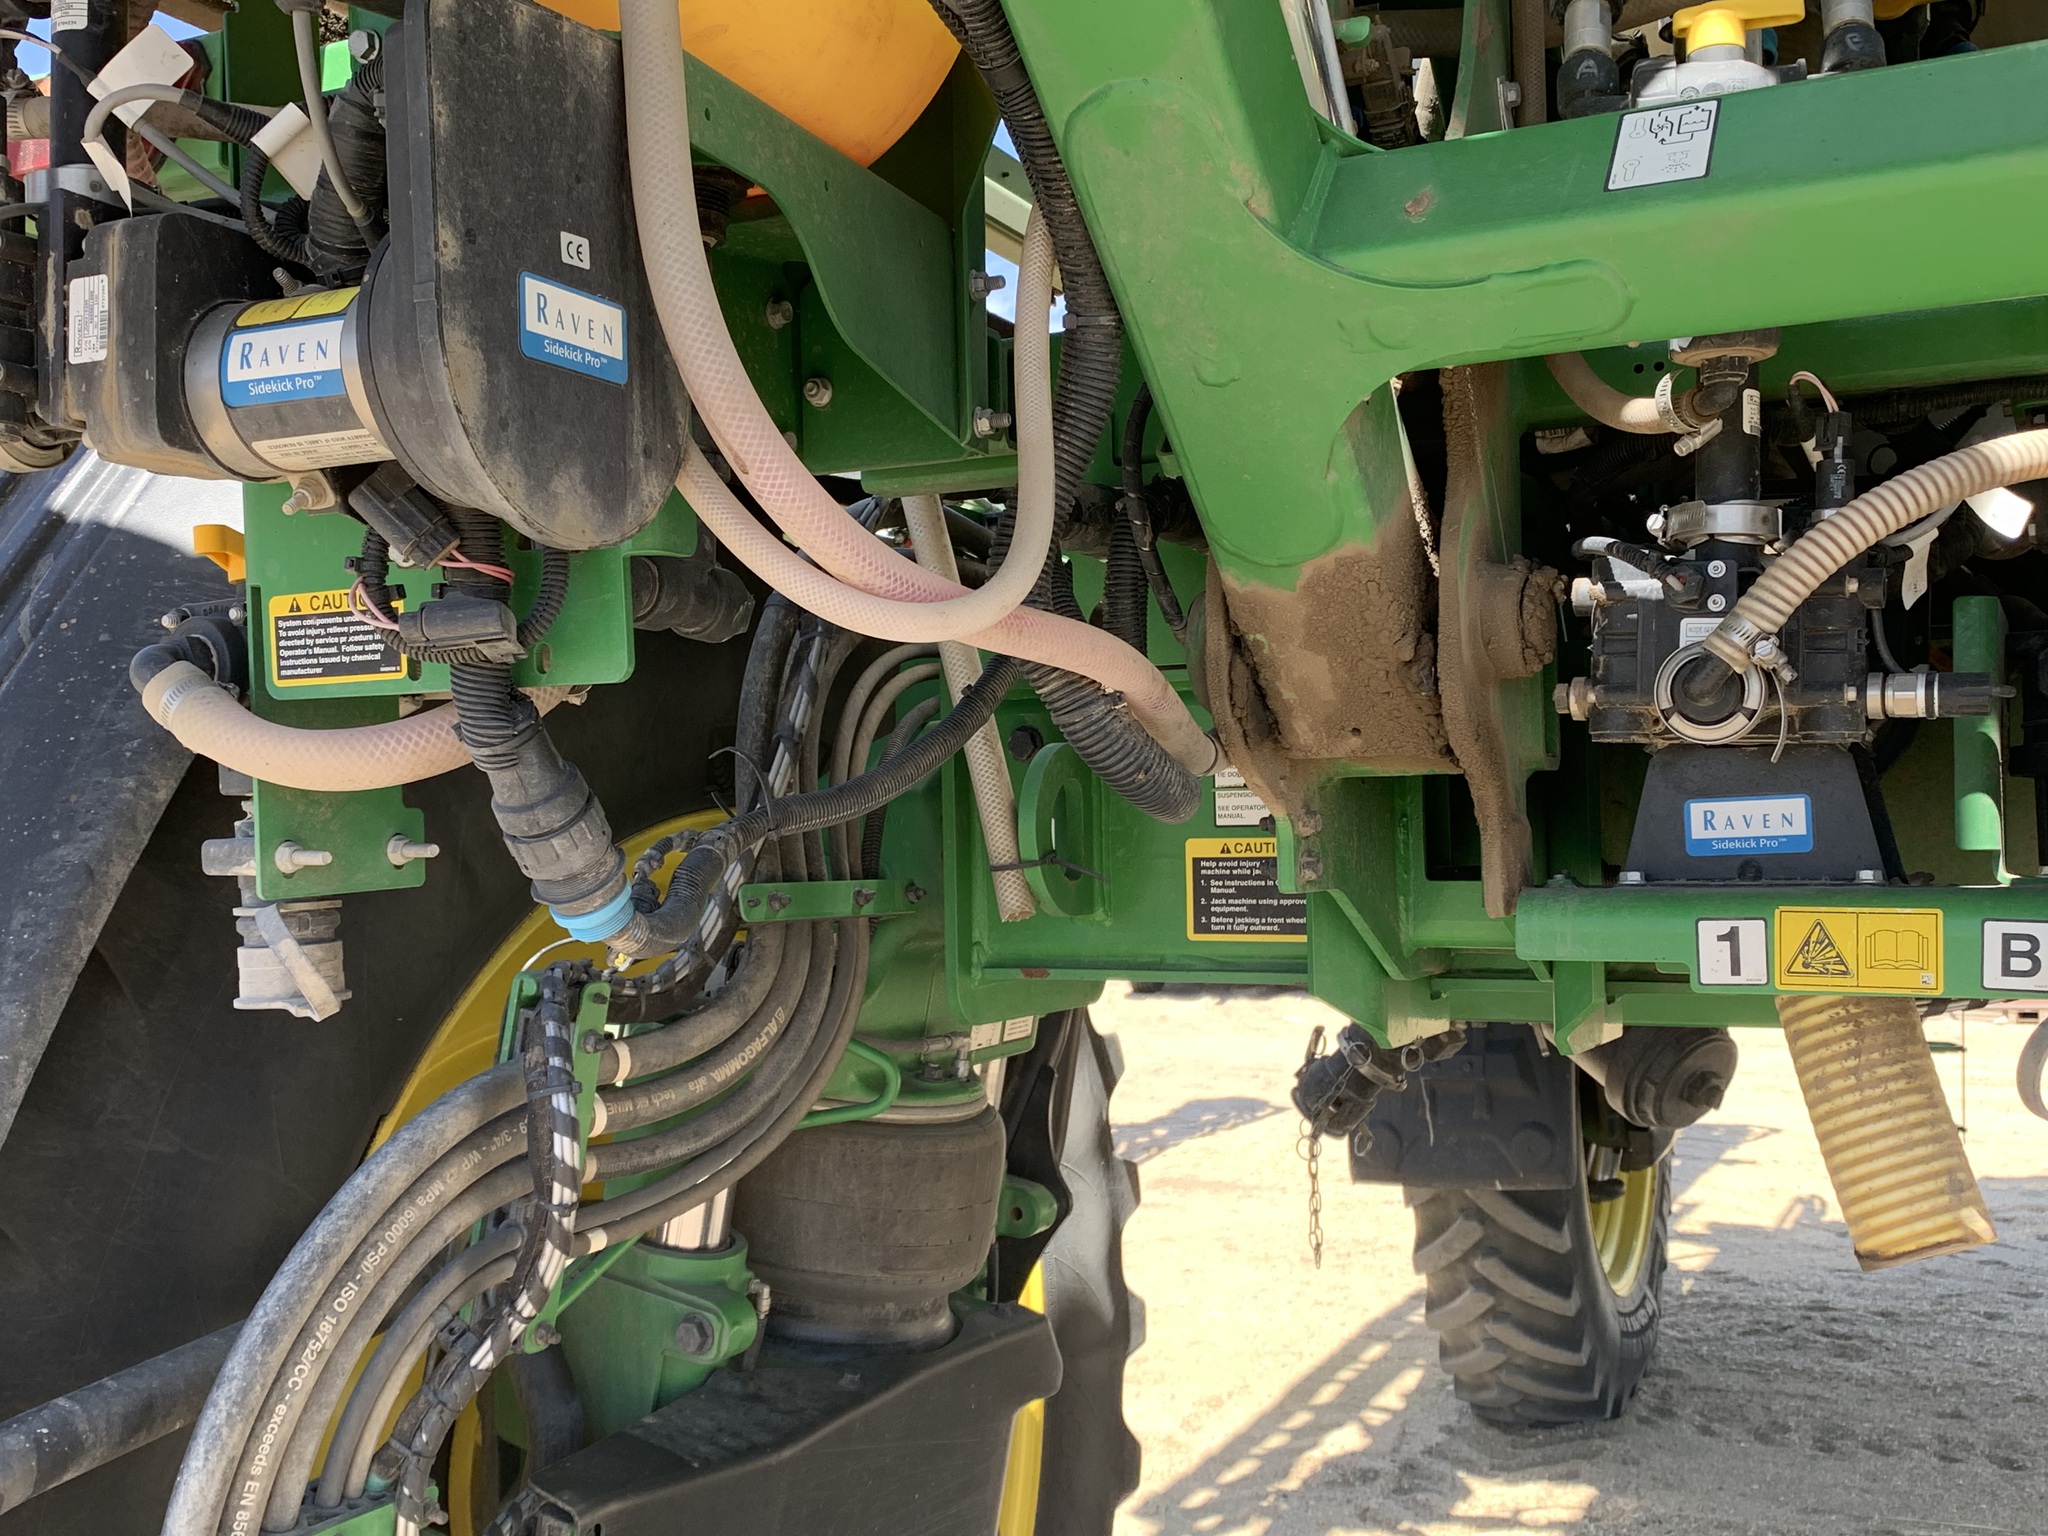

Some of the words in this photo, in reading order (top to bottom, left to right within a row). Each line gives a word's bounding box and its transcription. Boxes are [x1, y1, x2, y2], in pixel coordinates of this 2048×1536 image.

[1576, 58, 1598, 80] A
[536, 292, 613, 347] RAVEN
[240, 339, 328, 370] RAVEN
[544, 339, 583, 363] Sidekick
[248, 379, 293, 396] Sidekick
[278, 619, 302, 629] System
[288, 628, 305, 637] avoid
[306, 627, 326, 637] injury,
[327, 625, 348, 634] relieve
[279, 637, 305, 647] directed
[306, 638, 314, 646] by
[315, 636, 339, 645] service
[374, 632, 381, 640] in
[280, 648, 313, 658] Operator's
[341, 644, 363, 652] Follow
[364, 642, 385, 652] safety
[280, 657, 318, 667] instructions
[319, 655, 340, 664] issued
[341, 655, 350, 664] by
[351, 652, 381, 662] chemical
[281, 667, 324, 676] manufacturer
[1217, 791, 1254, 799] SUSPENSIO
[1703, 810, 1793, 831] RAVEN
[1233, 842, 1276, 854] CAUTI
[1712, 839, 1757, 850] Sidekick
[1200, 860, 1216, 868] Help
[1240, 860, 1260, 868] injury
[1210, 905, 1249, 913] equipment.
[1258, 898, 1278, 906] using
[1279, 898, 1307, 906] approve
[1233, 923, 1248, 932] fully
[1234, 916, 1260, 924] jacking
[1716, 925, 1742, 977] 1
[2000, 932, 2043, 978] B
[709, 1016, 779, 1084] ALFAGOMMA
[651, 1089, 676, 1107] tech
[461, 1149, 483, 1172] WP
[416, 1179, 446, 1207] MPa
[333, 1281, 360, 1313] ISO
[288, 1314, 338, 1391] 18752/CC
[251, 1402, 288, 1477] exceeds
[239, 1479, 261, 1506] EN
